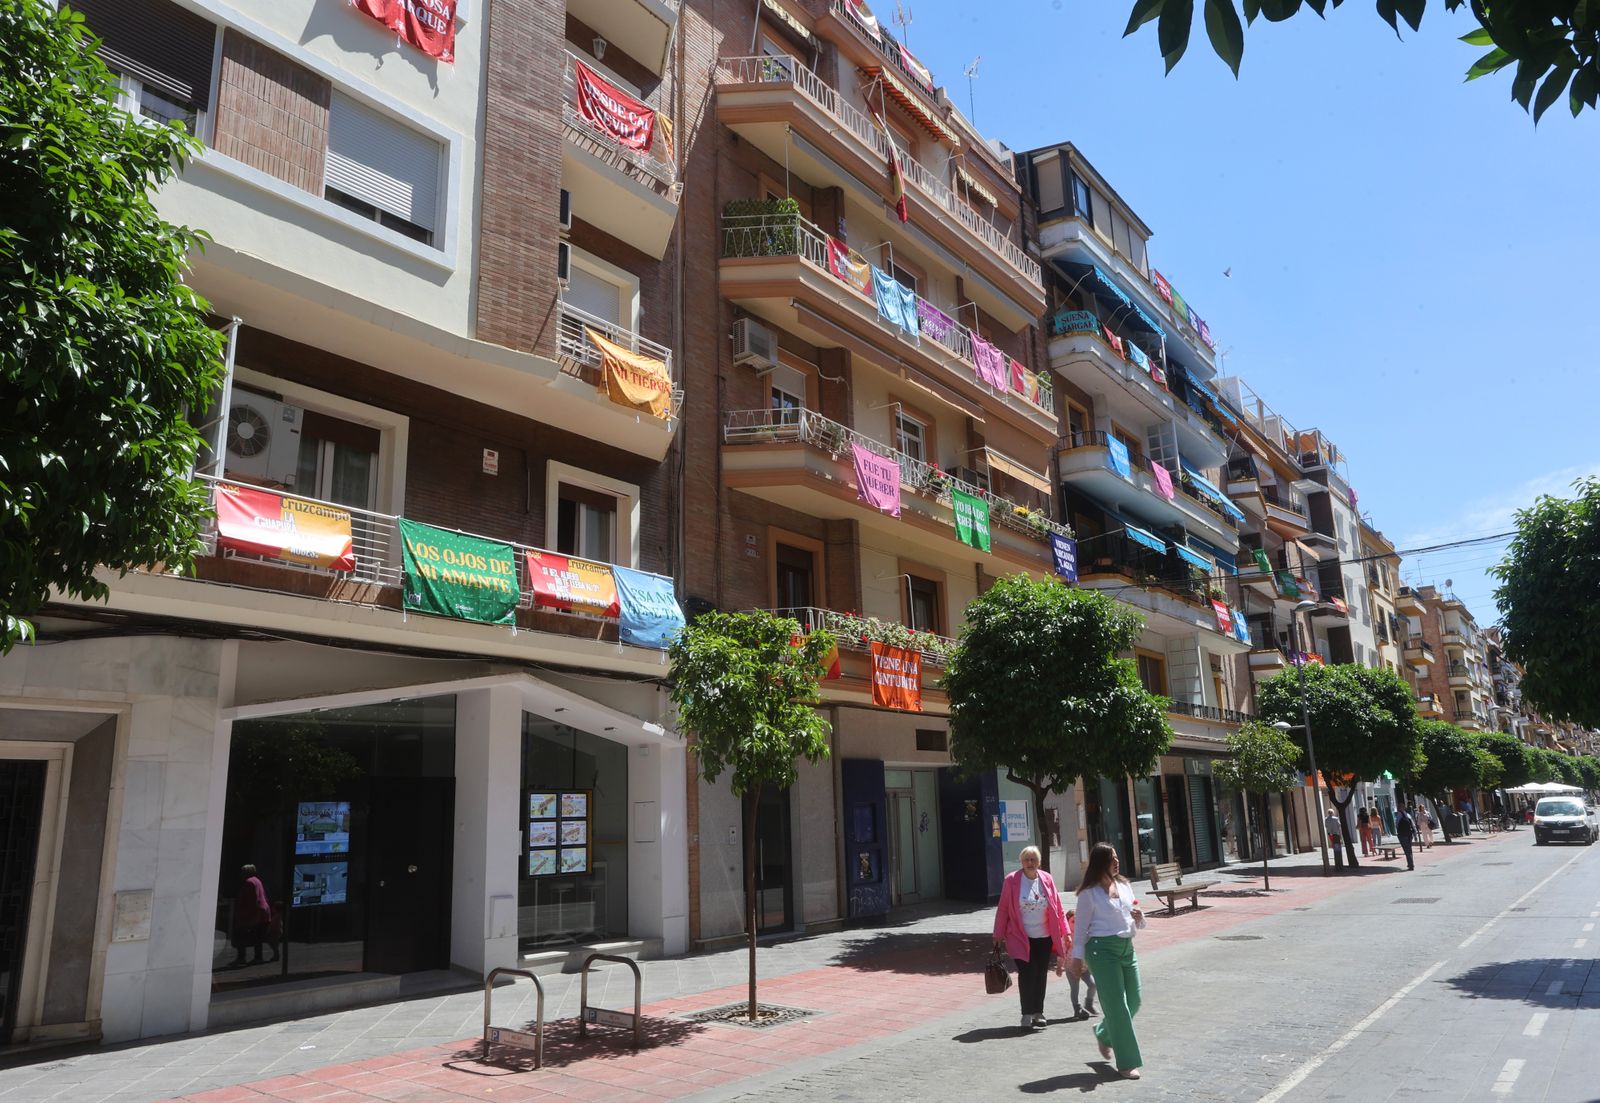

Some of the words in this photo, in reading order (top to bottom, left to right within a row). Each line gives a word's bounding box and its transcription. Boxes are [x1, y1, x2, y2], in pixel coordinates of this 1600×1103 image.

[863, 459, 880, 477] FUE
[880, 467, 892, 481] TU
[407, 538, 440, 561] LOS
[442, 549, 488, 571] OJOS
[489, 558, 513, 575] DE
[416, 560, 437, 581] MI
[442, 568, 512, 593] AMANTE
[874, 654, 901, 671] TIENE
[902, 660, 918, 675] UNA
